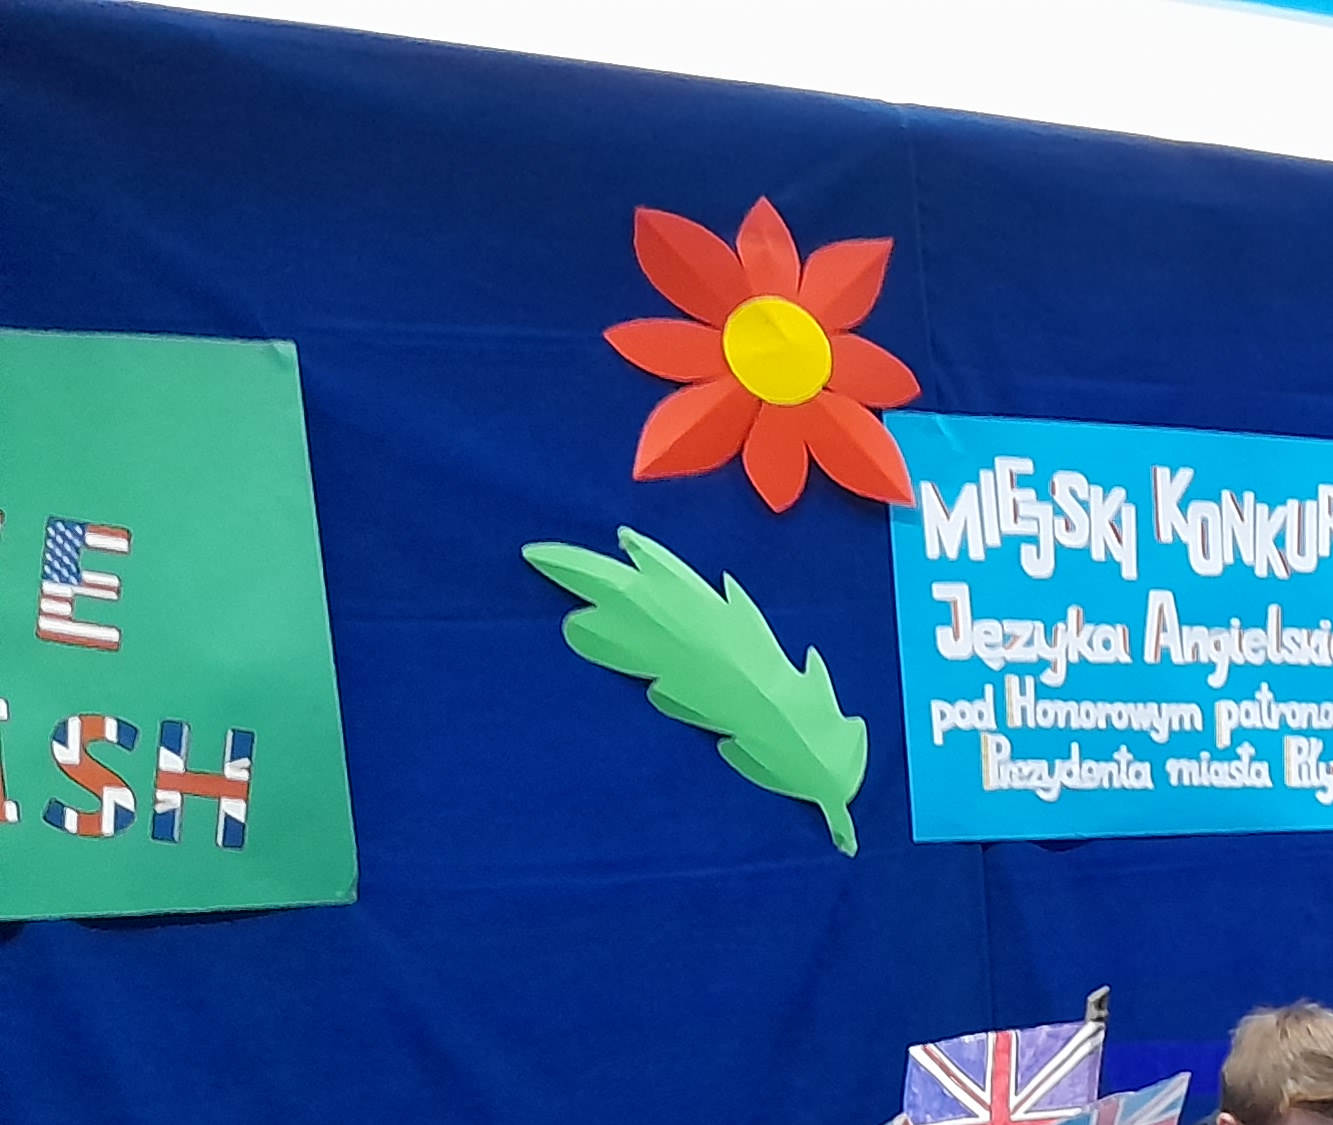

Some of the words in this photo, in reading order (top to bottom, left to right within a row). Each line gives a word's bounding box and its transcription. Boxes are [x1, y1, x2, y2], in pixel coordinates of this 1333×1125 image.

[920, 456, 1138, 580] MIEJSKI
[0, 510, 133, 651] E
[931, 582, 1132, 687] Języka
[930, 683, 996, 745] pod
[1005, 674, 1202, 743] Honorowym
[1166, 742, 1273, 789] miasta
